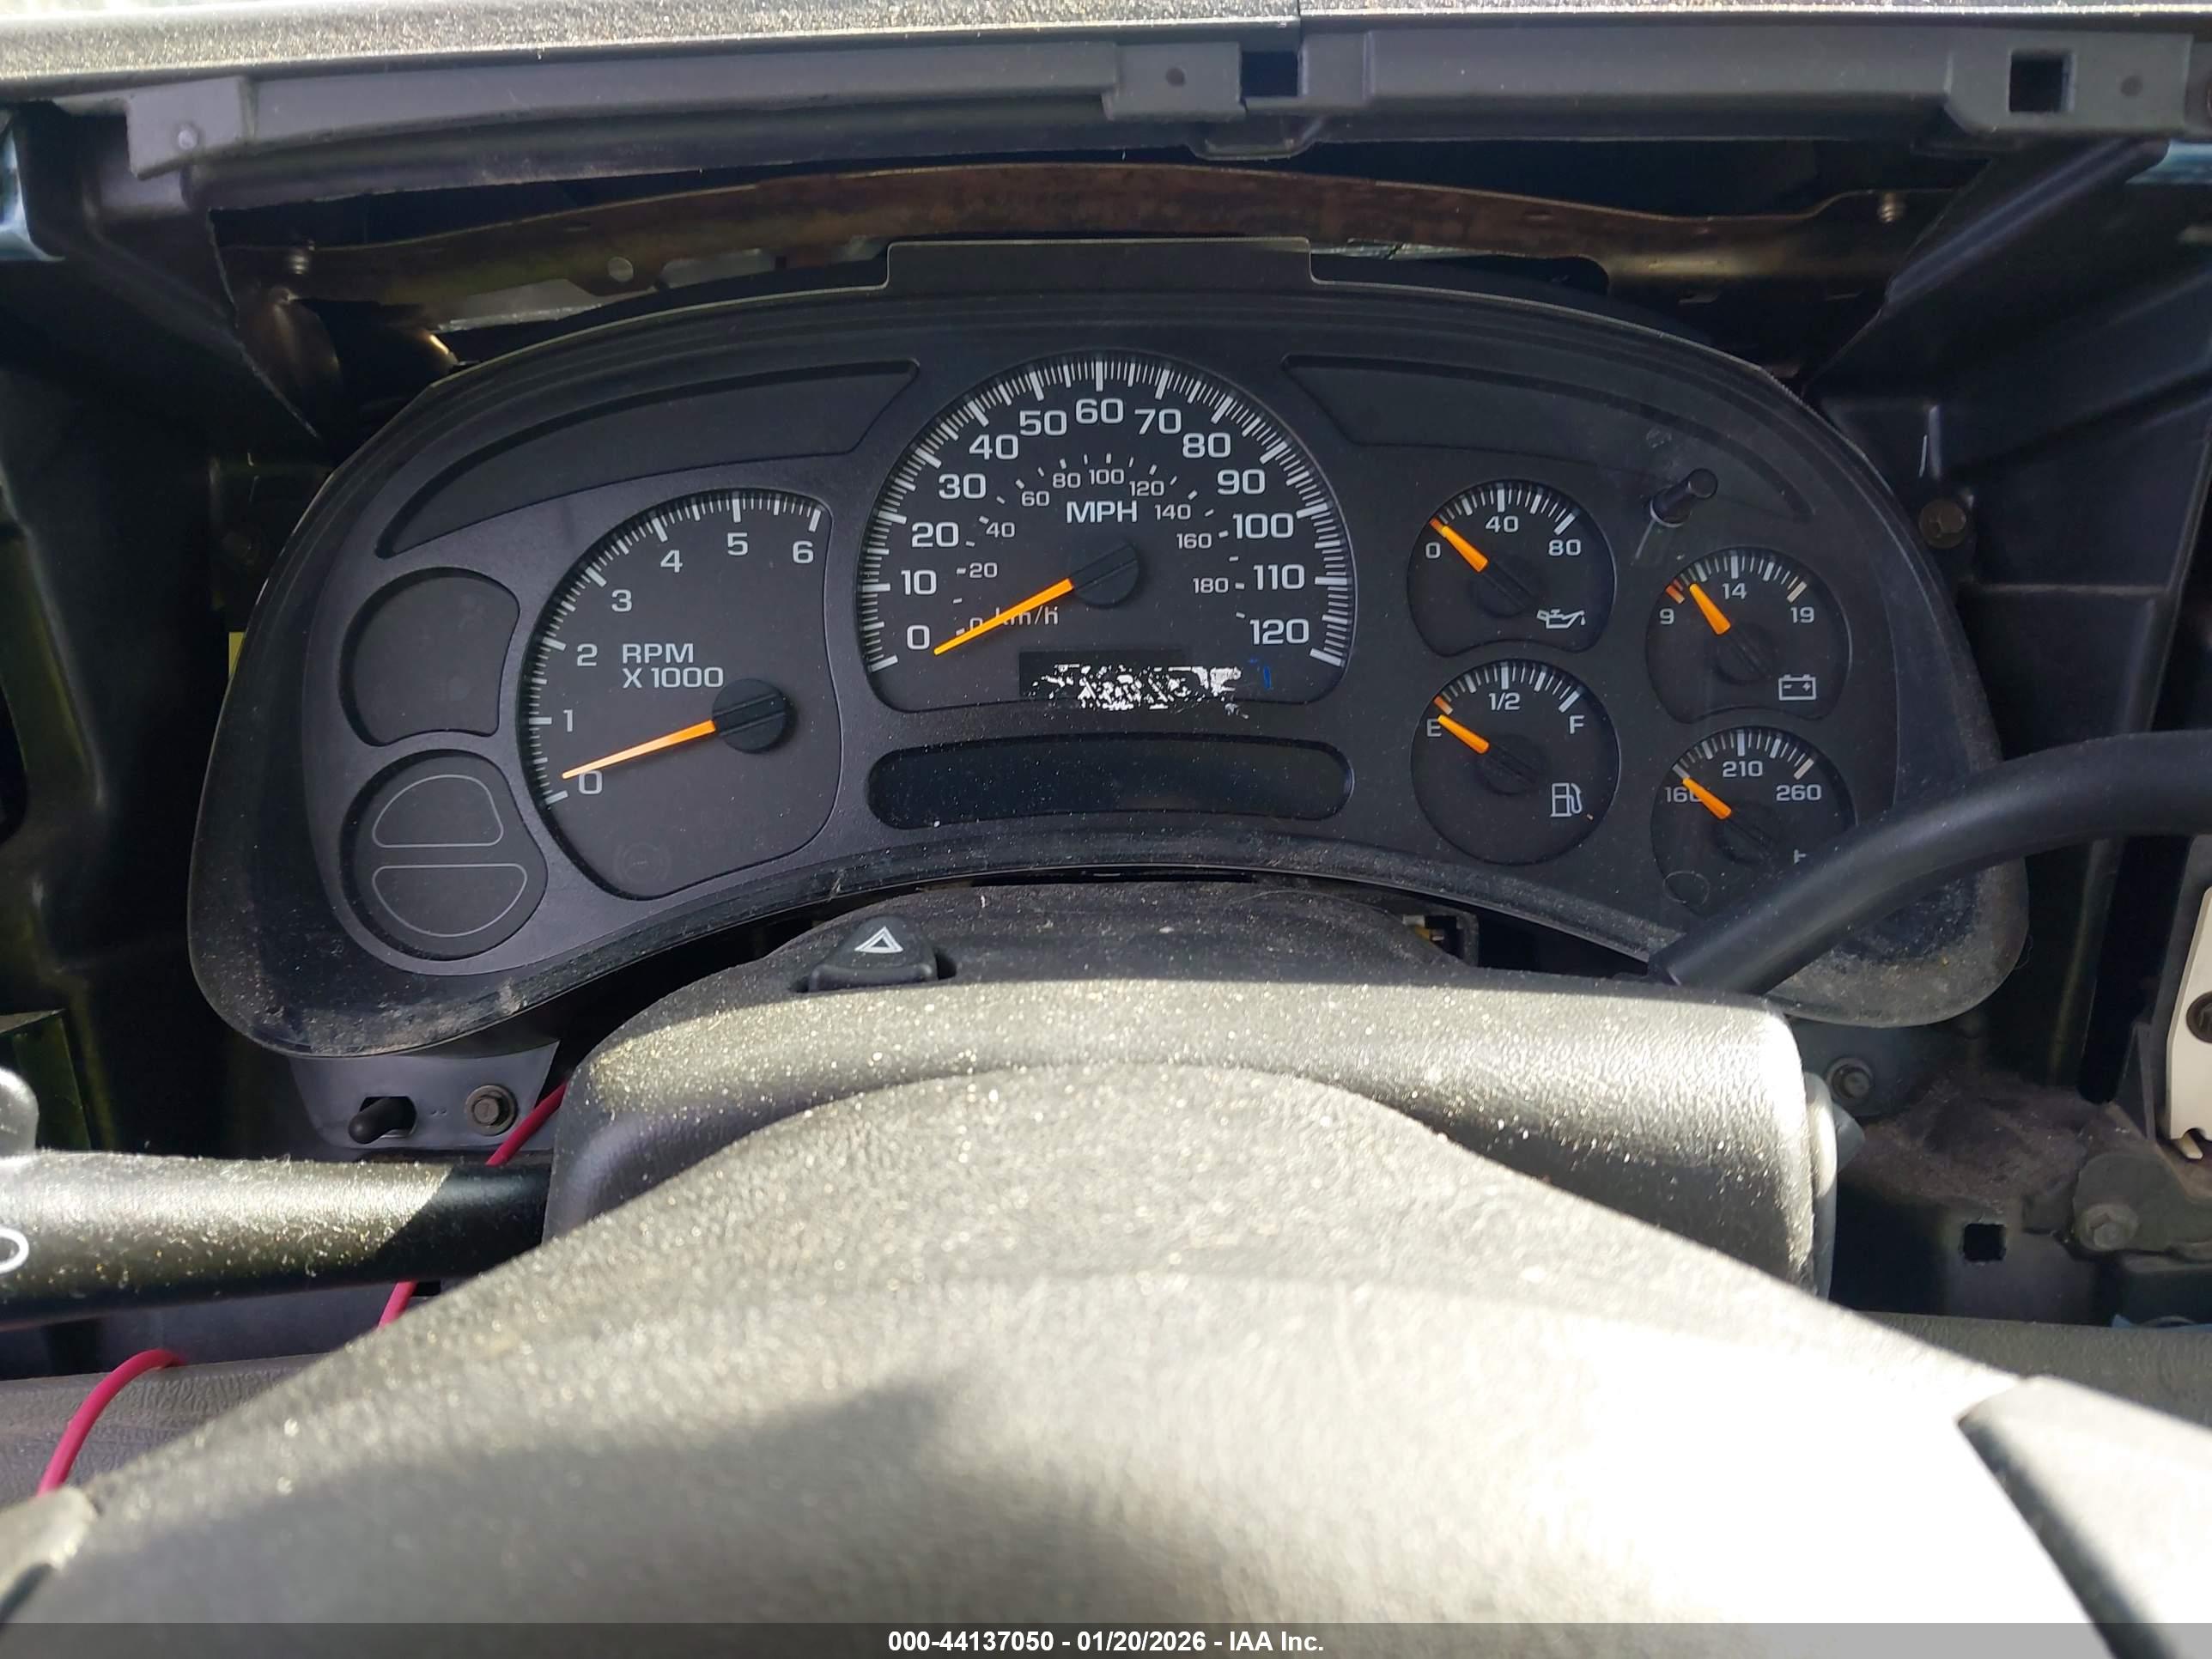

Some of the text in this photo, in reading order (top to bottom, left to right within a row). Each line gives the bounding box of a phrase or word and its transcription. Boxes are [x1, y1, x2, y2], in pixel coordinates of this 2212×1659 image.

[1075, 398, 1124, 424] 60
[1134, 409, 1182, 434] 70
[1019, 410, 1067, 436] 50
[969, 434, 1018, 460] 40
[1182, 432, 1231, 459] 80
[939, 473, 987, 499] 30
[1052, 472, 1081, 489] 80
[1089, 469, 1125, 485] 100
[1129, 480, 1164, 496] 120
[1217, 469, 1266, 495] 90
[1021, 490, 1050, 507] 60
[1066, 500, 1138, 524] MPH
[1154, 504, 1191, 520] 140
[911, 521, 959, 548] 20
[986, 522, 1015, 538] 40
[1232, 513, 1294, 539] 100
[1485, 515, 1519, 533] 40
[727, 532, 748, 556] 5
[793, 540, 814, 564] 6
[1176, 532, 1212, 549] 160
[1425, 542, 1441, 559] 0
[1548, 538, 1582, 556] 80
[660, 550, 684, 573] 4
[969, 562, 998, 579] 20
[901, 569, 937, 595] 10
[1193, 577, 1229, 593] 180
[1253, 564, 1305, 591] 110
[611, 589, 633, 612] 3
[1722, 582, 1747, 599] 14
[1659, 608, 1674, 625] 9
[1790, 606, 1814, 623] 19
[907, 624, 930, 650] 0
[1249, 618, 1310, 645] 120
[576, 643, 598, 666] 2
[623, 643, 694, 664] RPM
[622, 666, 724, 689] X 1000
[1488, 692, 1521, 711] 1/2
[562, 709, 573, 732] 1
[1426, 719, 1443, 738] E
[1569, 714, 1585, 734] F
[1723, 760, 1763, 778] 210
[579, 770, 603, 795] 0
[1776, 784, 1822, 801] 260
